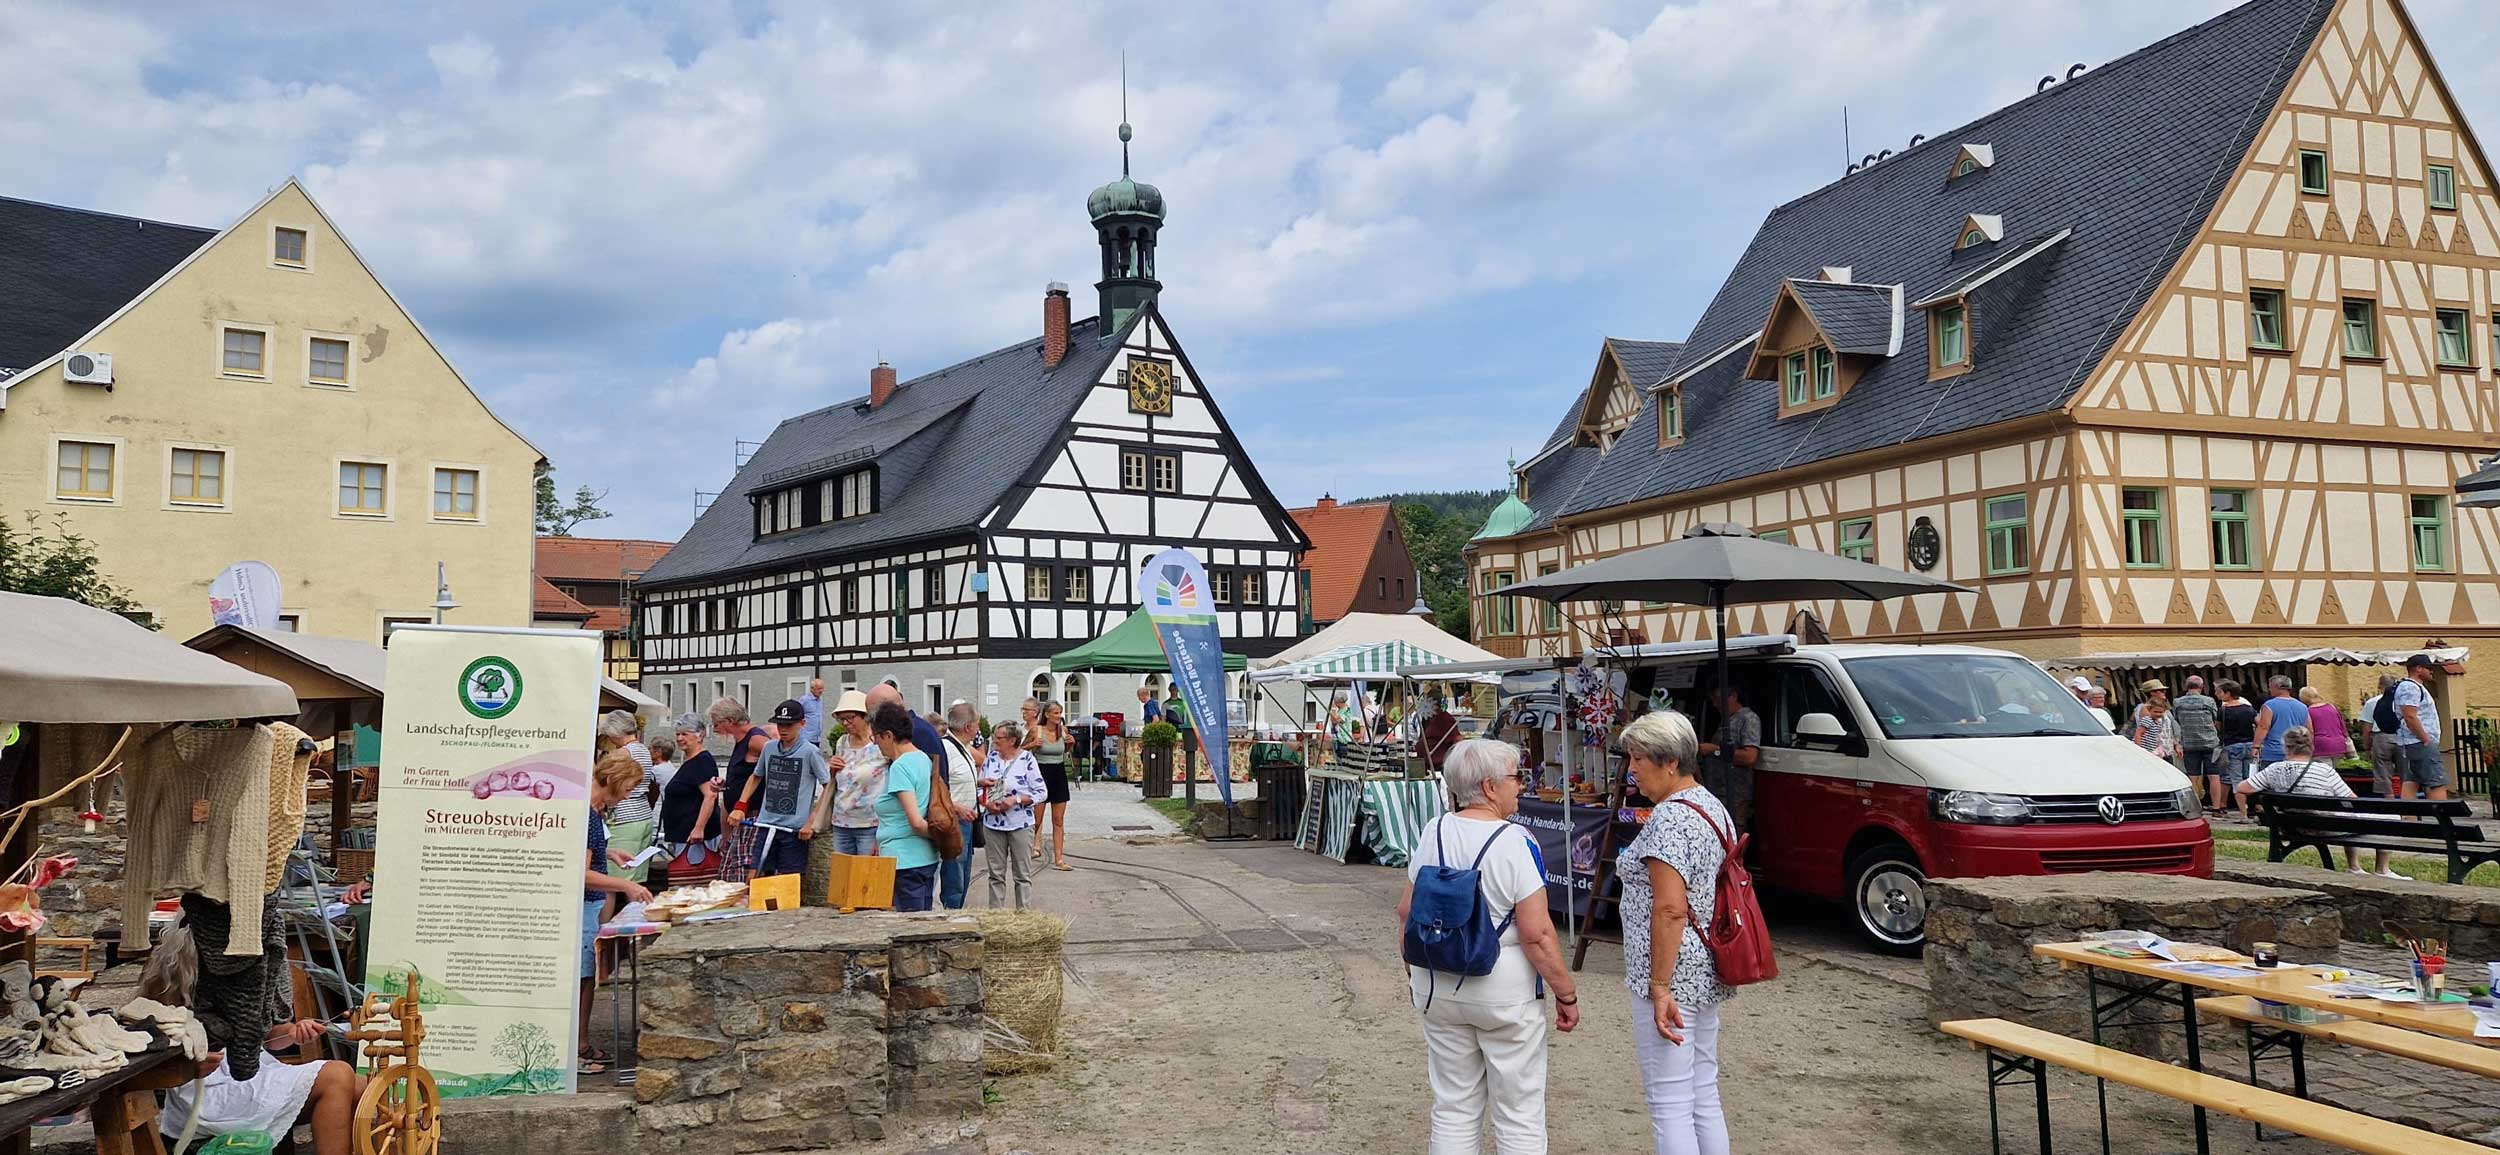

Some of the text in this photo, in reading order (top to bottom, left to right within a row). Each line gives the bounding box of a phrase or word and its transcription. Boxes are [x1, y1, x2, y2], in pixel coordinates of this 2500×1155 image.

[406, 723, 567, 740] Landschaftspflegeverband
[404, 767, 450, 776] Im Garten
[403, 777, 470, 787] der Frau Holle
[426, 809, 567, 831] Streuobstvielfalt
[424, 826, 537, 839] im Mittleren Erzgebirge
